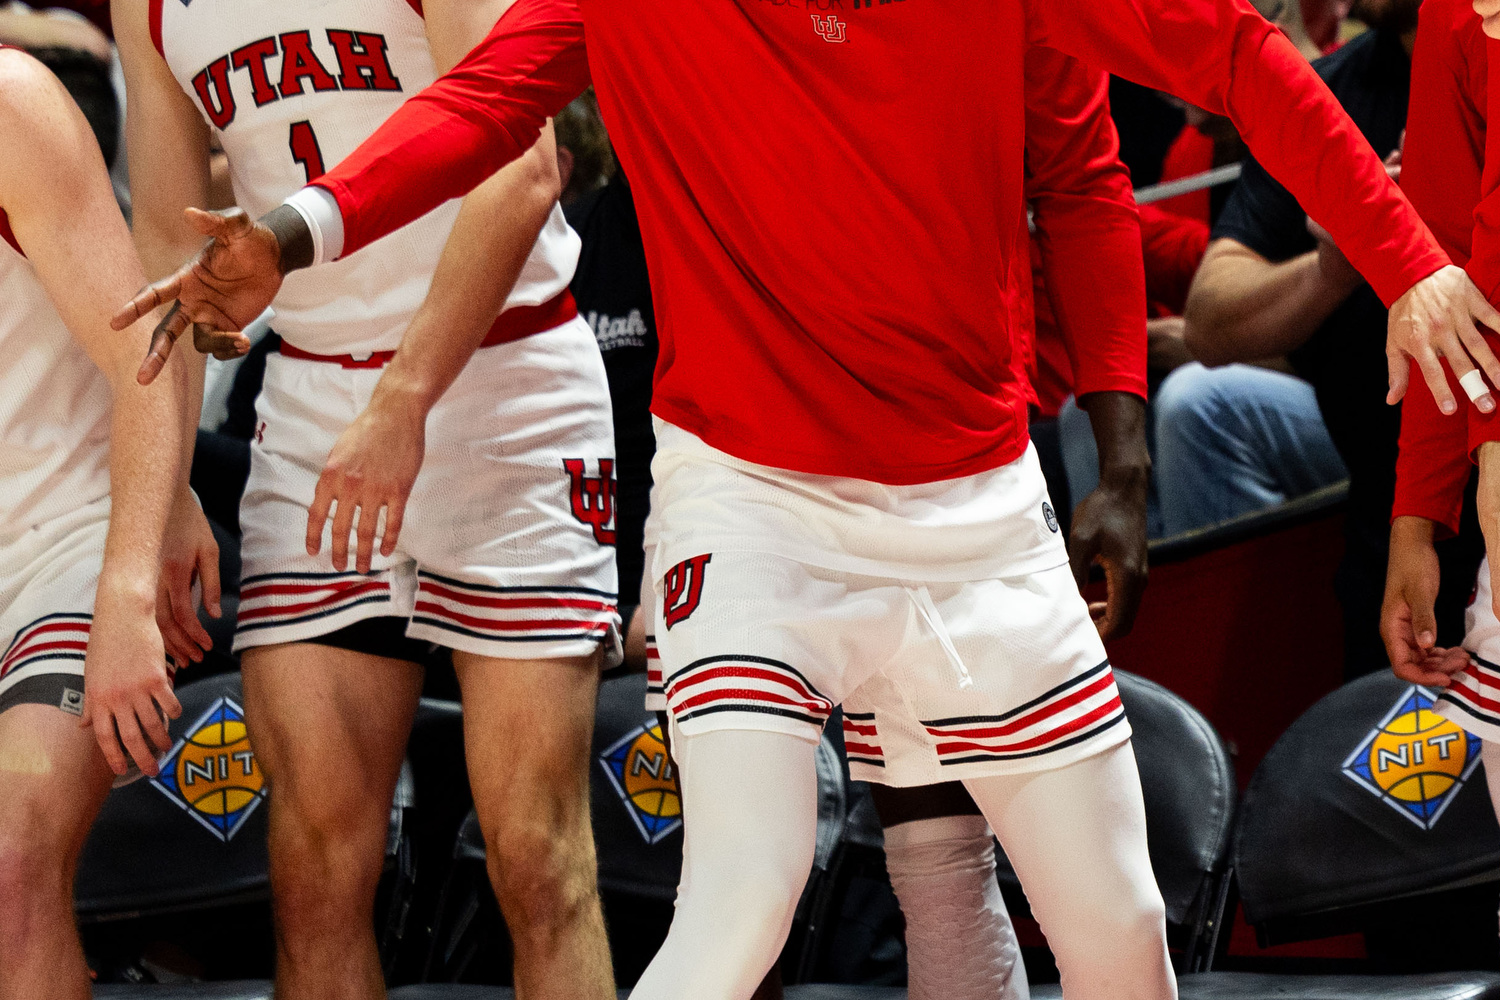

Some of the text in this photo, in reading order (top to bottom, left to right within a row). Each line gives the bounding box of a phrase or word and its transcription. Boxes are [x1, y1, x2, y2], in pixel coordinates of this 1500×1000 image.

[191, 28, 403, 131] UTAH
[288, 119, 326, 184] 1
[184, 751, 255, 788] NIT
[1378, 731, 1461, 773] NIT
